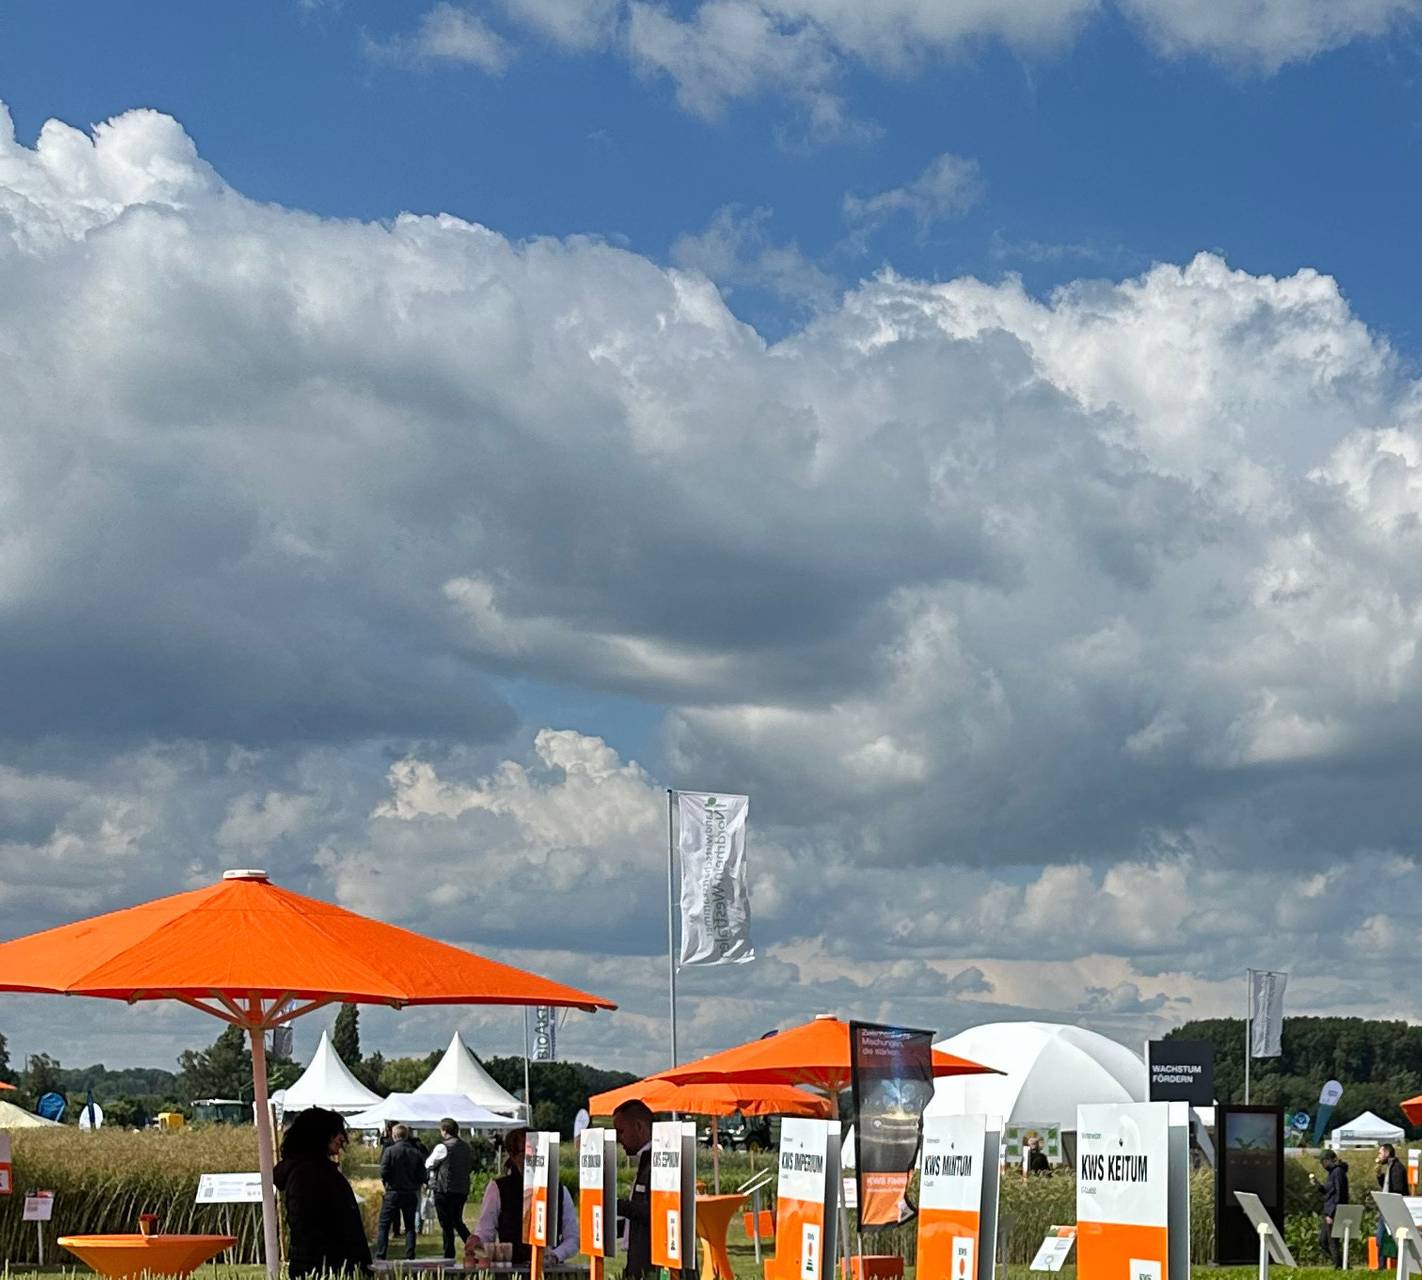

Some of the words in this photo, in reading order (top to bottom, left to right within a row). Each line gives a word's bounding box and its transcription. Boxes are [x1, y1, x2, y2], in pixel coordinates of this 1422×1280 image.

[1152, 1065, 1202, 1073] WACHSTUM
[1152, 1074, 1194, 1083] FÖRDERN
[782, 1151, 793, 1170] KWS
[924, 1155, 940, 1176] KWS
[1081, 1154, 1104, 1181] KWS
[1108, 1155, 1148, 1182] KEITUM
